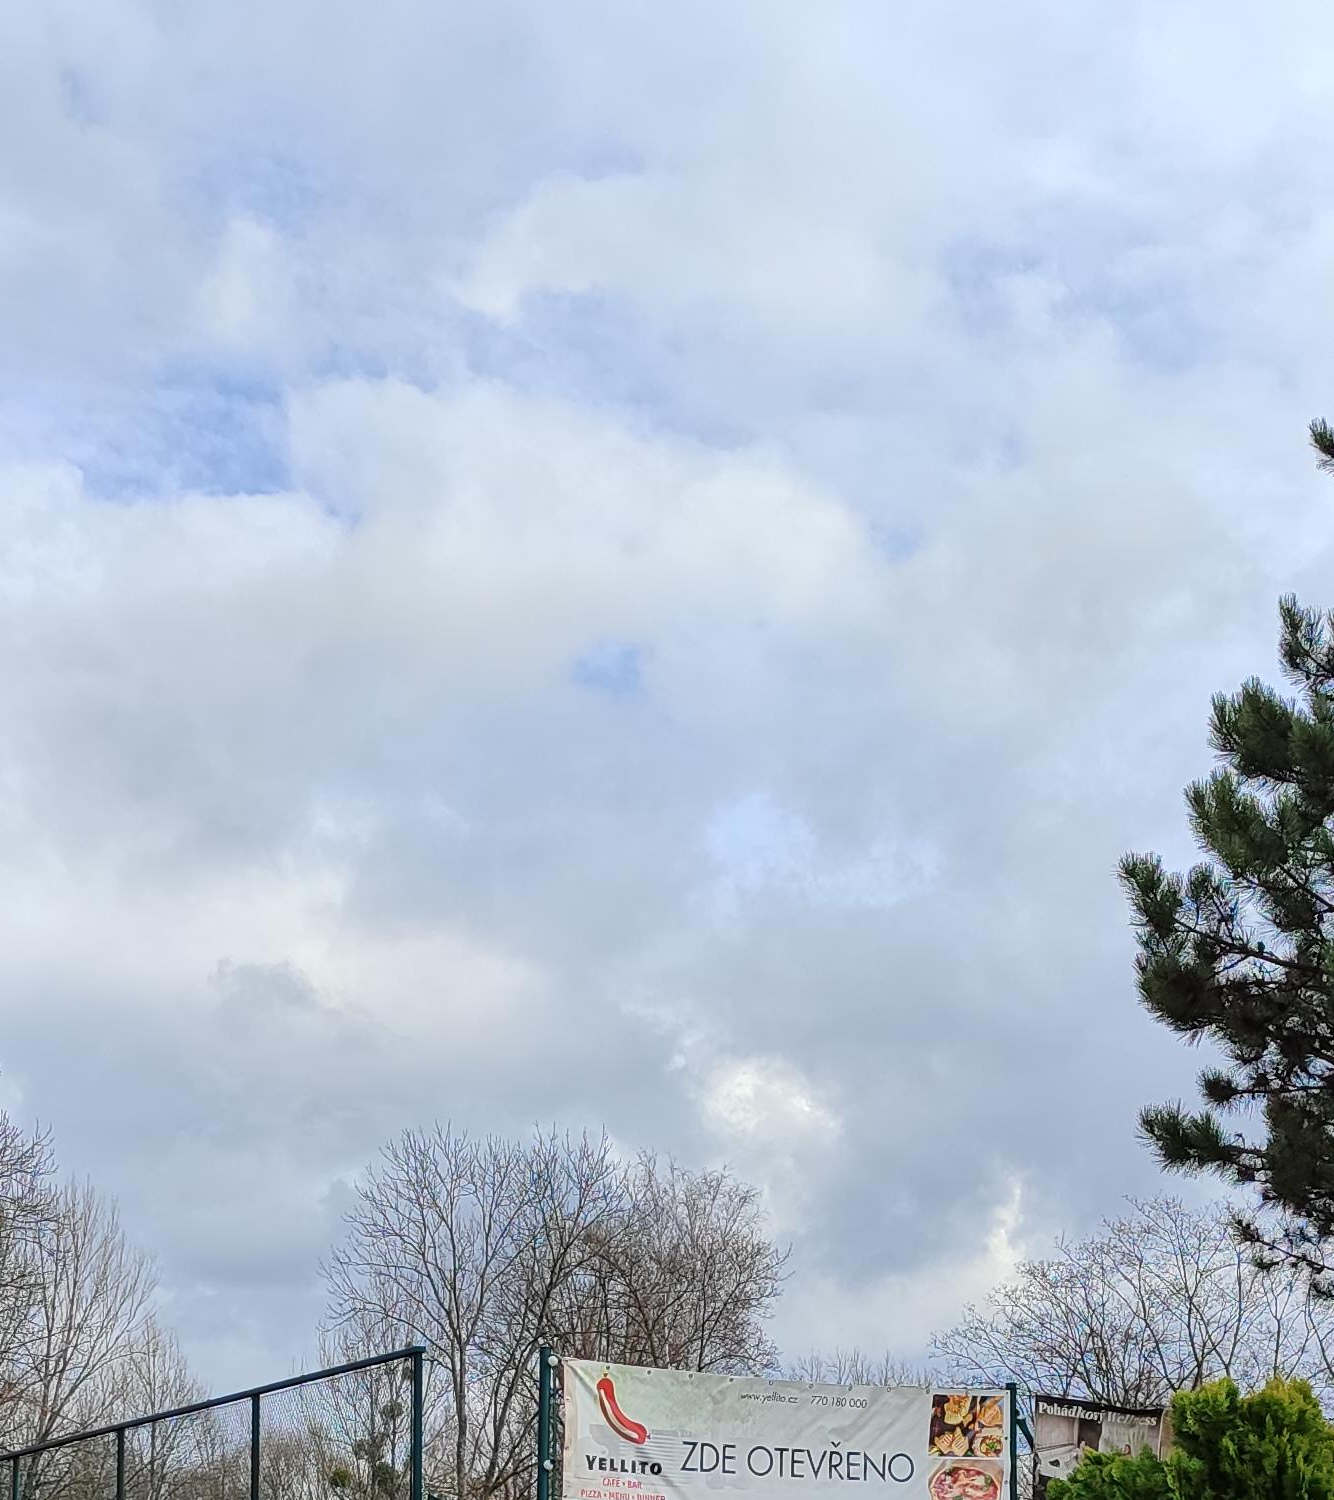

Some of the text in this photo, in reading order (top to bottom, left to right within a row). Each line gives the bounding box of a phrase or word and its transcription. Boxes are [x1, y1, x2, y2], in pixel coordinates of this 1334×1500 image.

[811, 1395, 828, 1406] 770
[832, 1395, 847, 1407] 180
[849, 1397, 867, 1409] 000
[1107, 1410, 1157, 1426] Wellness
[585, 1454, 663, 1476] YELLITO
[680, 1441, 915, 1483] ZDE OTEVŘENO
[627, 1479, 642, 1489] BAR
[580, 1488, 602, 1499] PIZZA
[608, 1490, 630, 1500] MENU
